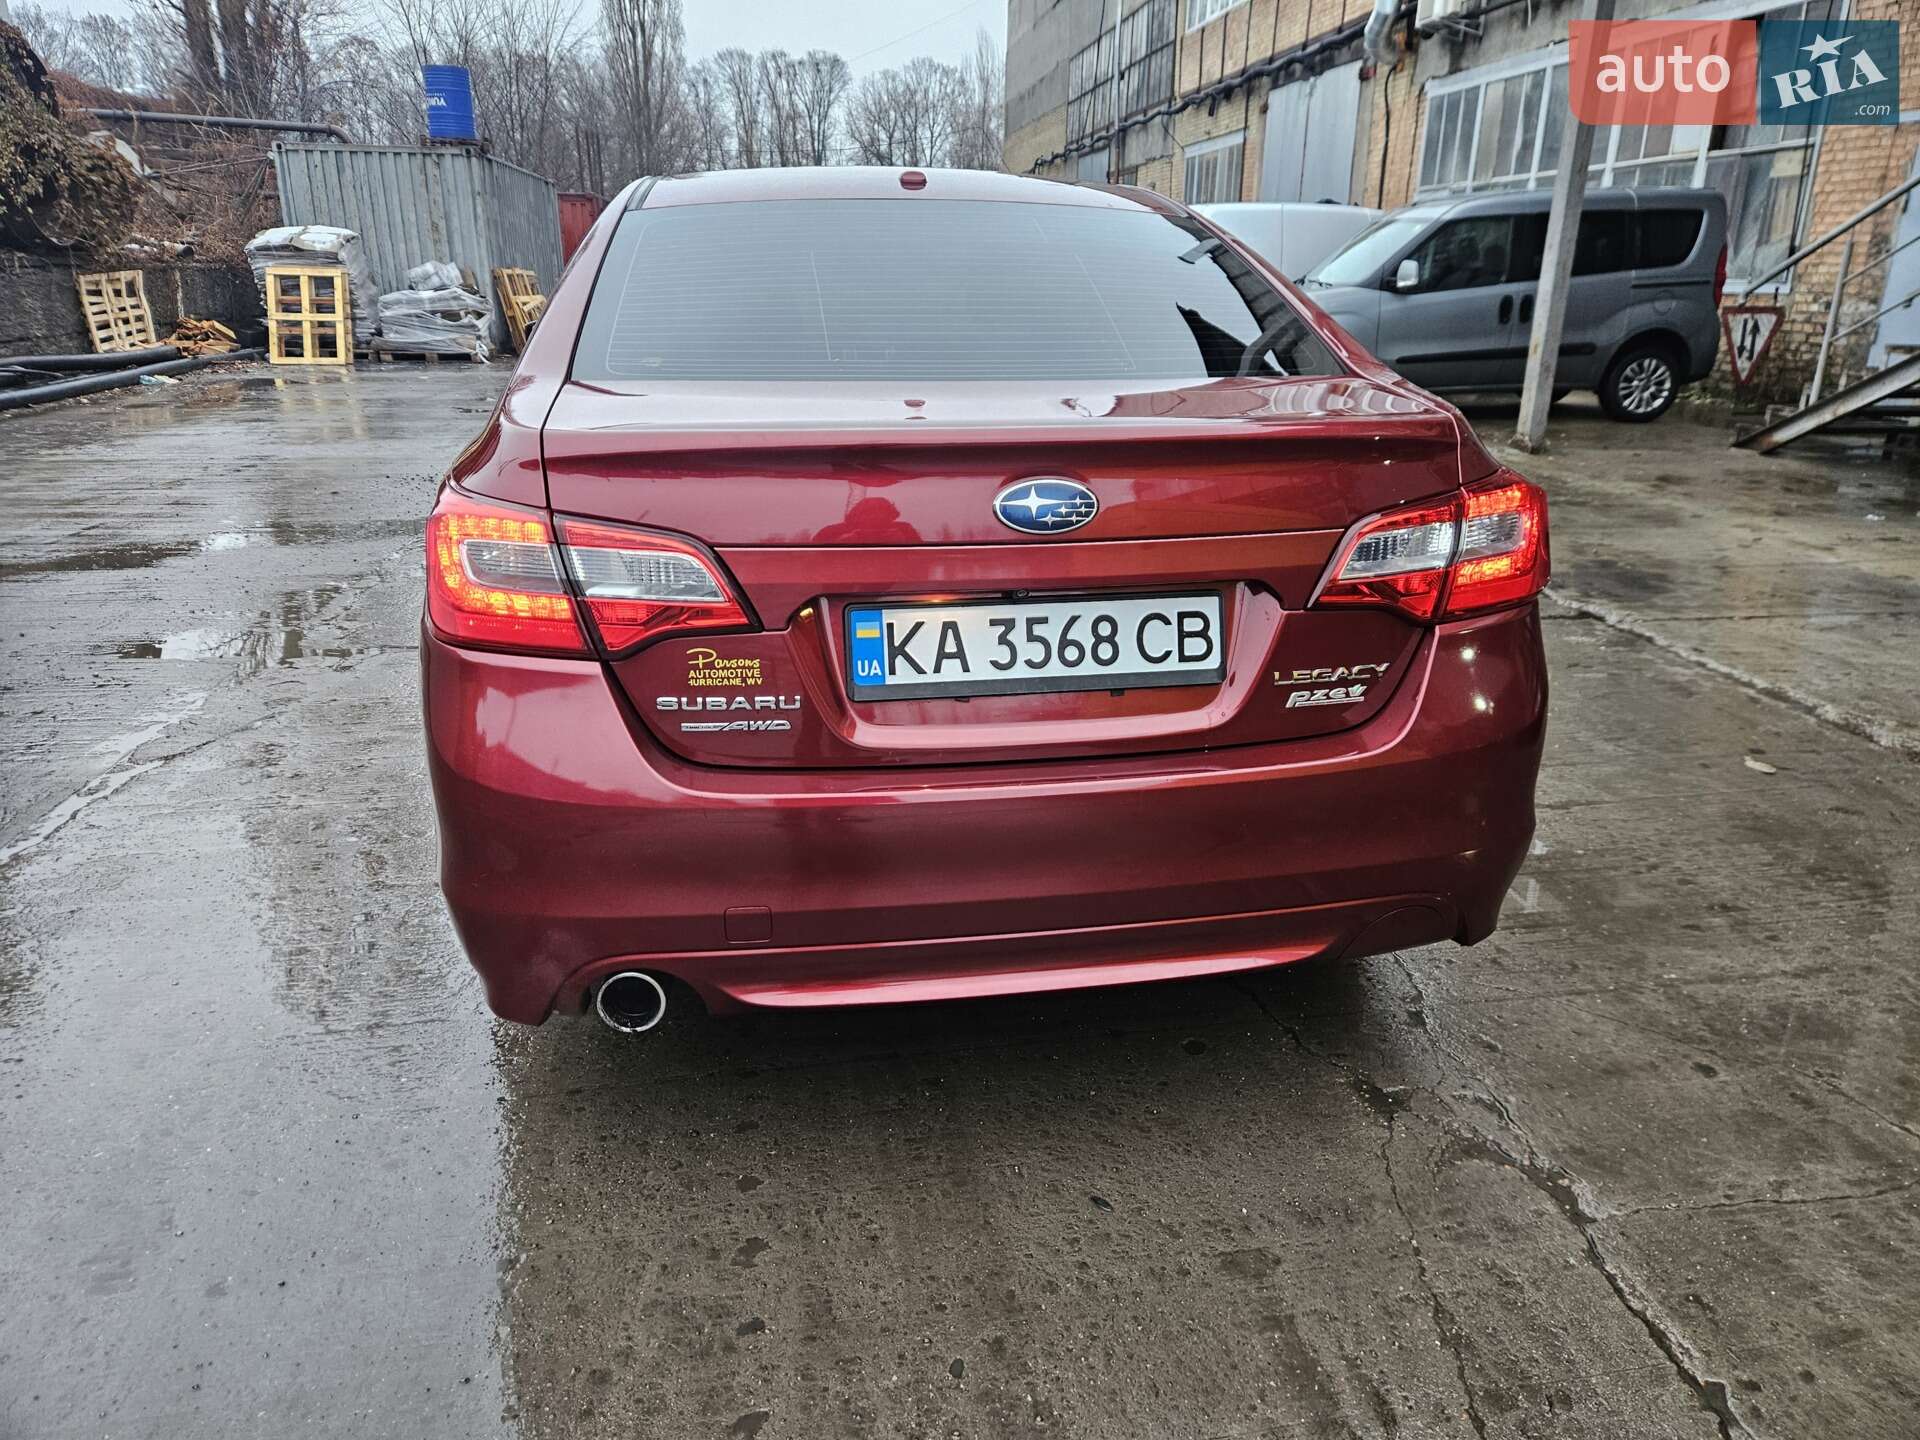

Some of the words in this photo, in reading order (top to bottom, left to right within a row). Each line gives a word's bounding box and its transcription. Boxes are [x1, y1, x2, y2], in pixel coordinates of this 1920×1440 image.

[886, 620, 971, 676] KA
[988, 614, 1120, 670] 3568
[1136, 610, 1213, 664] CB
[686, 647, 761, 669] Parsons
[688, 668, 761, 678] AUTOMOTIVE
[857, 659, 882, 677] UA
[1273, 662, 1390, 685] LEGACY
[746, 677, 763, 686] WV
[656, 695, 801, 711] SUBARU
[721, 719, 792, 731] AWD
